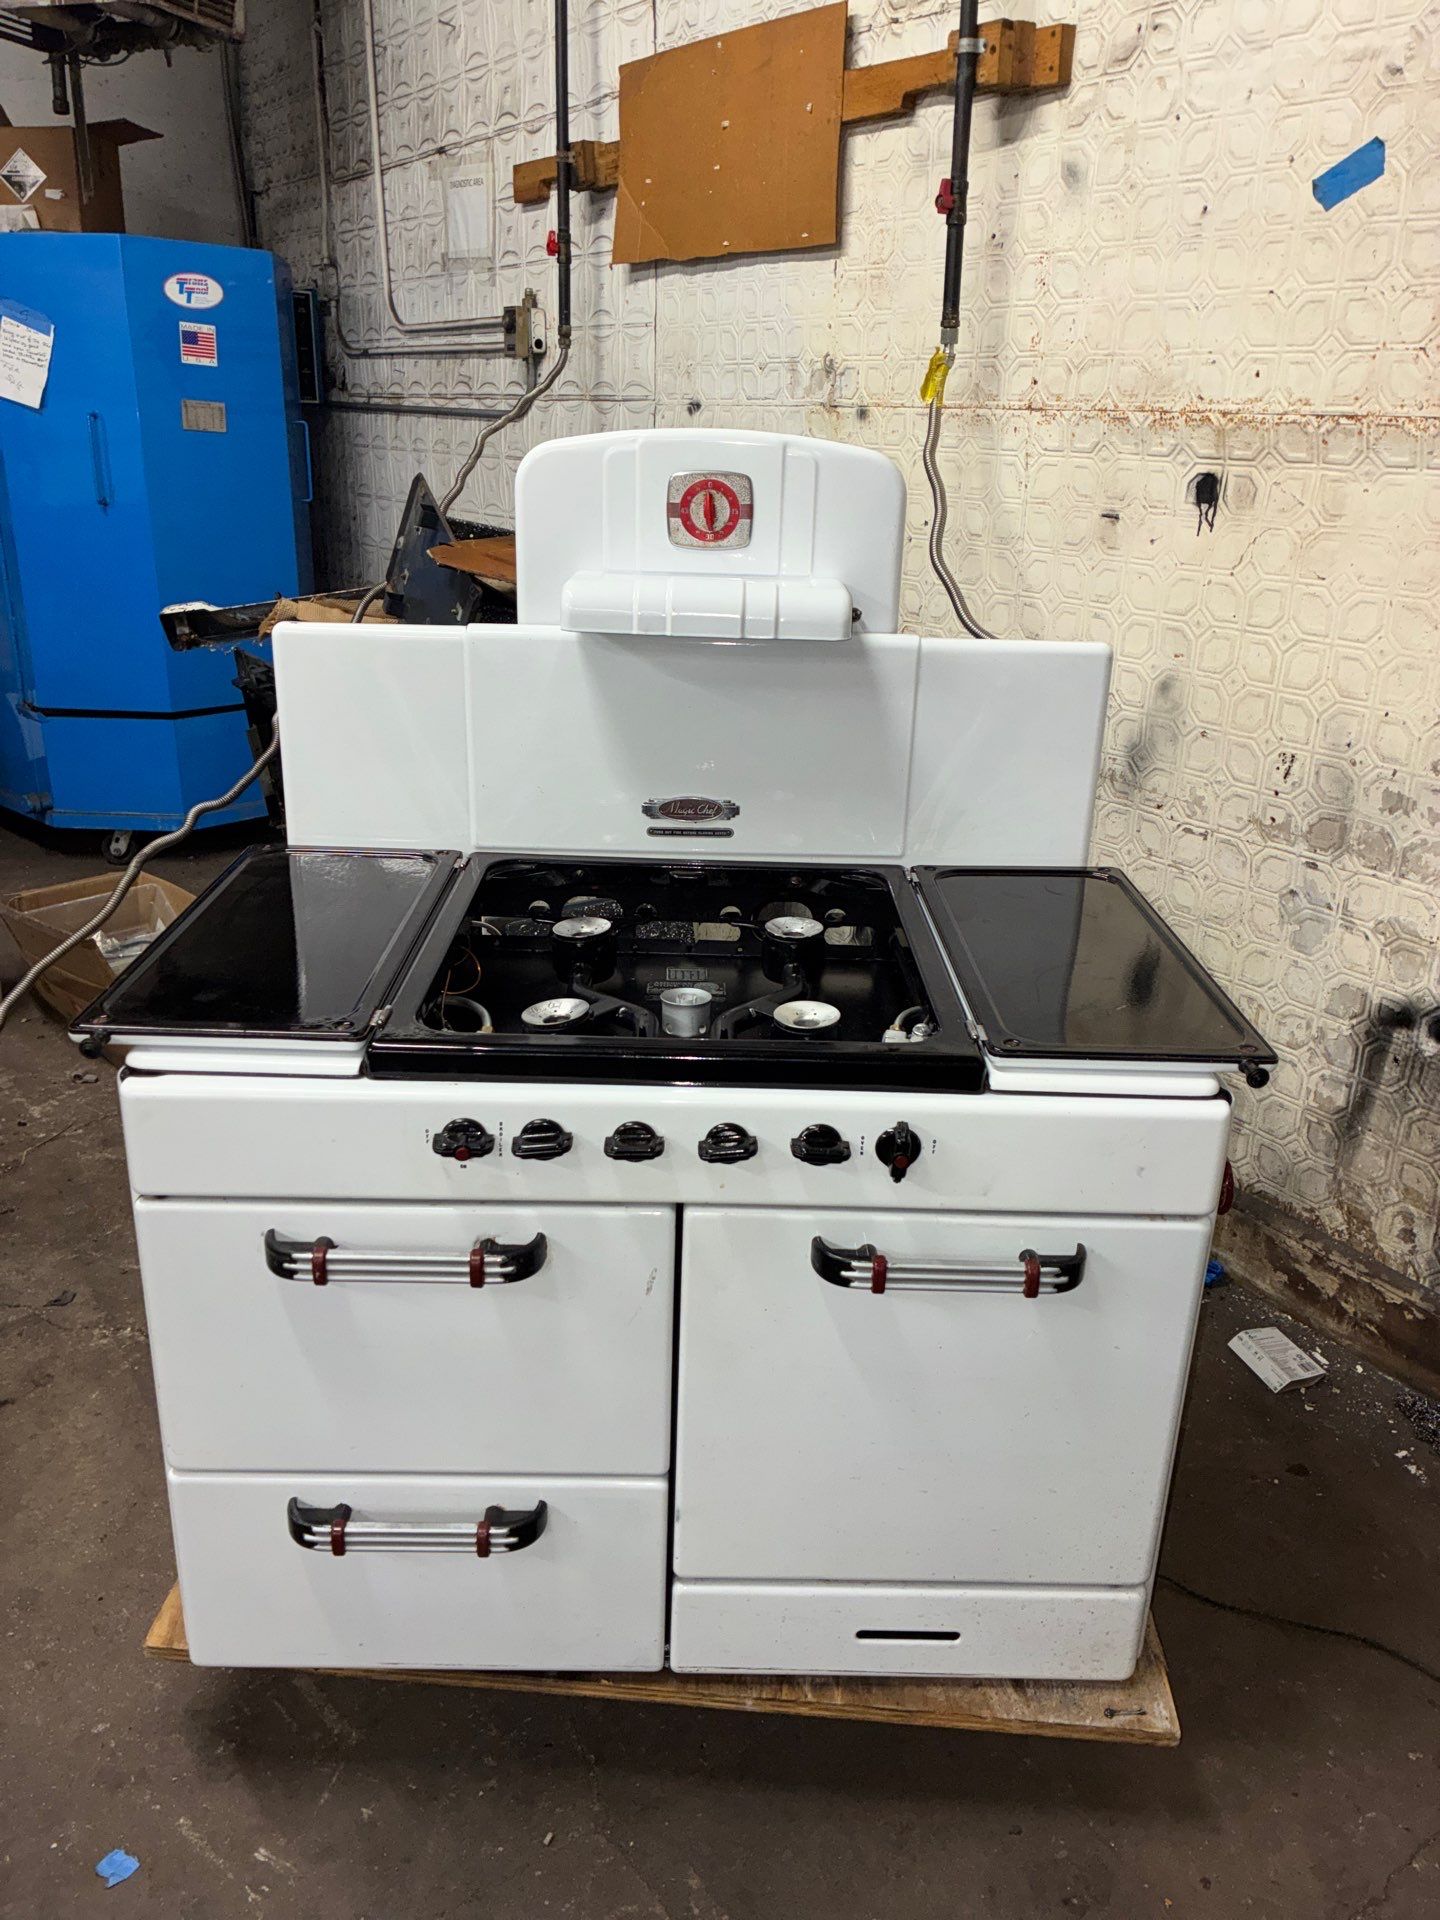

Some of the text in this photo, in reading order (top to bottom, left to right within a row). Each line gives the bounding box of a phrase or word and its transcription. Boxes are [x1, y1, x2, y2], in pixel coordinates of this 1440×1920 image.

[473, 177, 484, 186] AREA
[181, 323, 202, 331] MADE
[661, 801, 718, 817] Magic Chef
